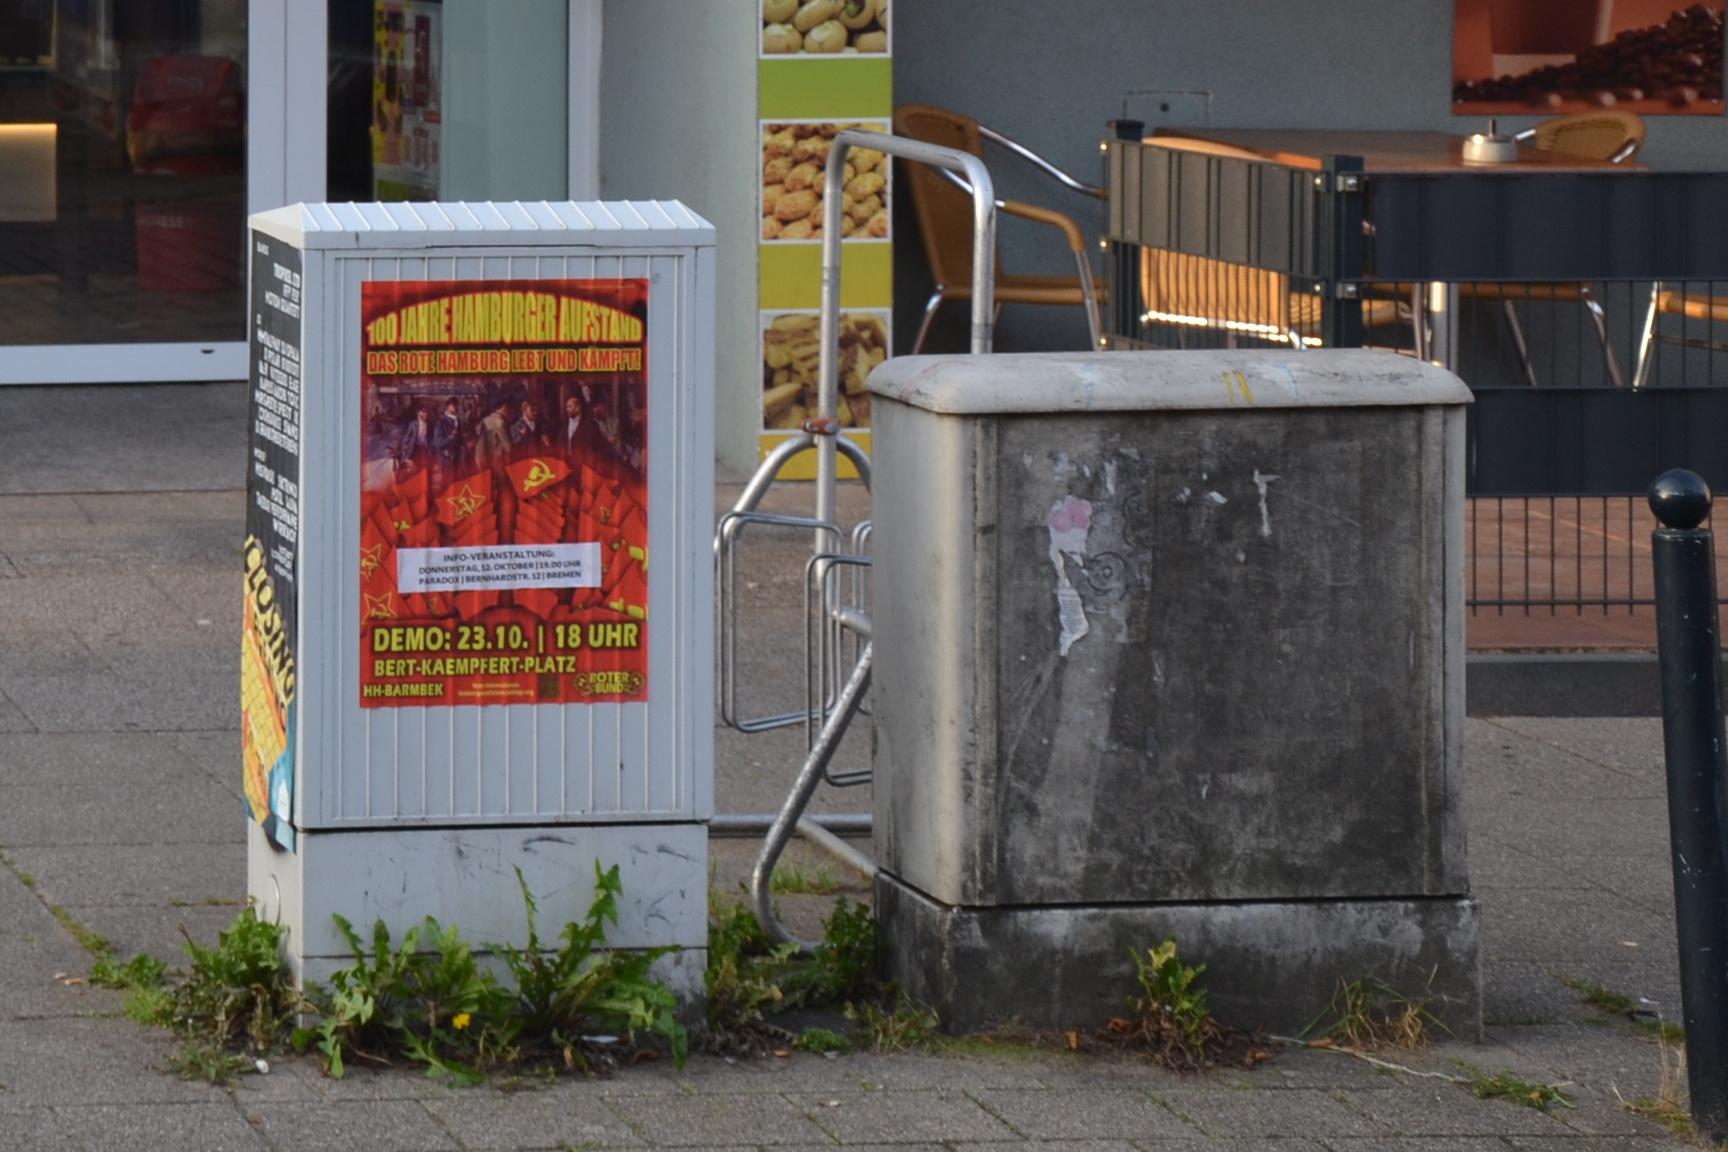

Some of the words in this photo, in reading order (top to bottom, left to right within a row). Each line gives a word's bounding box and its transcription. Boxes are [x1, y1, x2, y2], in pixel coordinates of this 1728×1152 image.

[367, 312, 397, 346] 100
[400, 298, 450, 344] JAHRE
[452, 291, 557, 344] HAMBURGER
[559, 296, 642, 343] AUFSTAND
[367, 351, 398, 374] DAS
[399, 350, 437, 373] ROTE
[437, 350, 510, 373] HAMBURG
[512, 349, 545, 372] LEBT
[546, 349, 577, 372] UND
[443, 549, 555, 562] INFO-VERANSTALTUNG:
[494, 562, 534, 572] OKTOBER
[564, 559, 581, 568] UHR
[419, 575, 460, 586] PARADOX
[546, 570, 581, 580] BREMEN
[374, 627, 451, 652] DEMO:
[457, 625, 529, 650] 23.10.
[555, 624, 581, 648] 18
[588, 623, 638, 647] UHR
[374, 655, 576, 677] BERT-KAEMPFERT-PLATZ
[589, 671, 630, 684] ROTER
[363, 683, 444, 697] HH-BARMBEK
[595, 682, 624, 694] BUND
